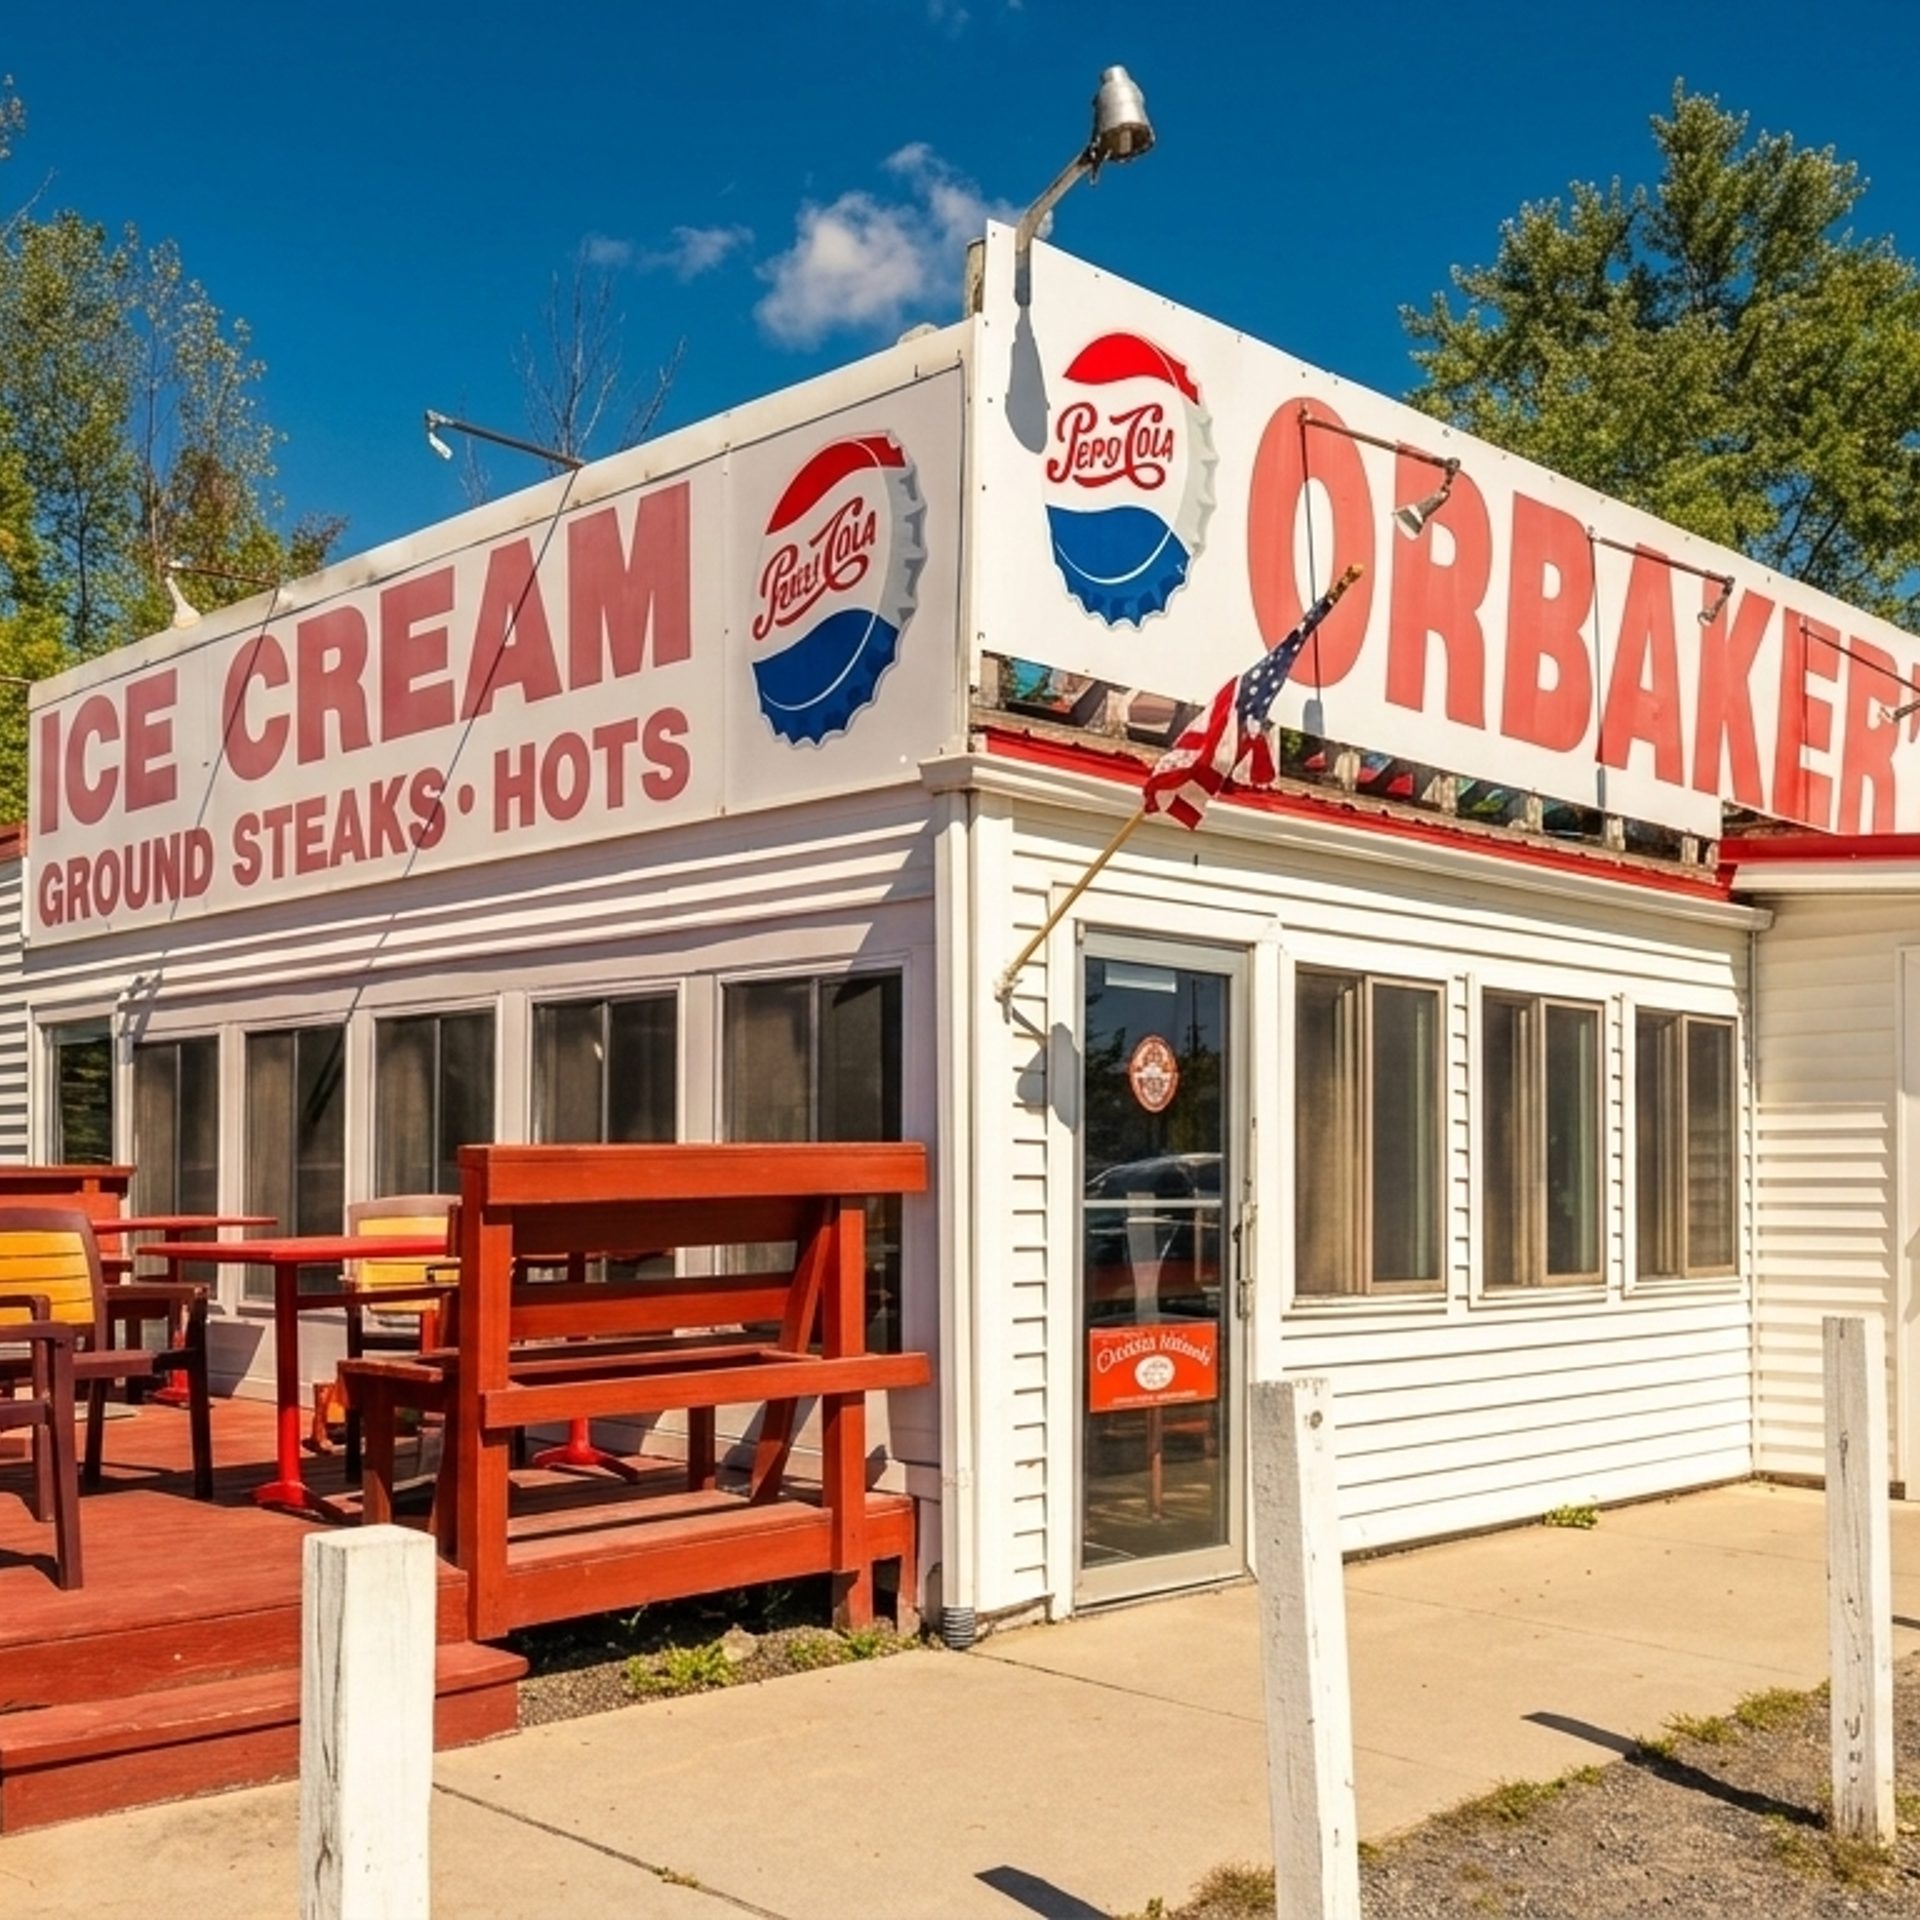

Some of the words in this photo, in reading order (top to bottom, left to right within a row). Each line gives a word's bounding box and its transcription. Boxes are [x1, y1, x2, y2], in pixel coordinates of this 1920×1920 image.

[39, 668, 178, 836] ICE
[222, 480, 691, 781] CREAM
[38, 826, 214, 928] GROUND
[232, 767, 447, 887] STEAKS
[494, 707, 691, 833] HOTS
